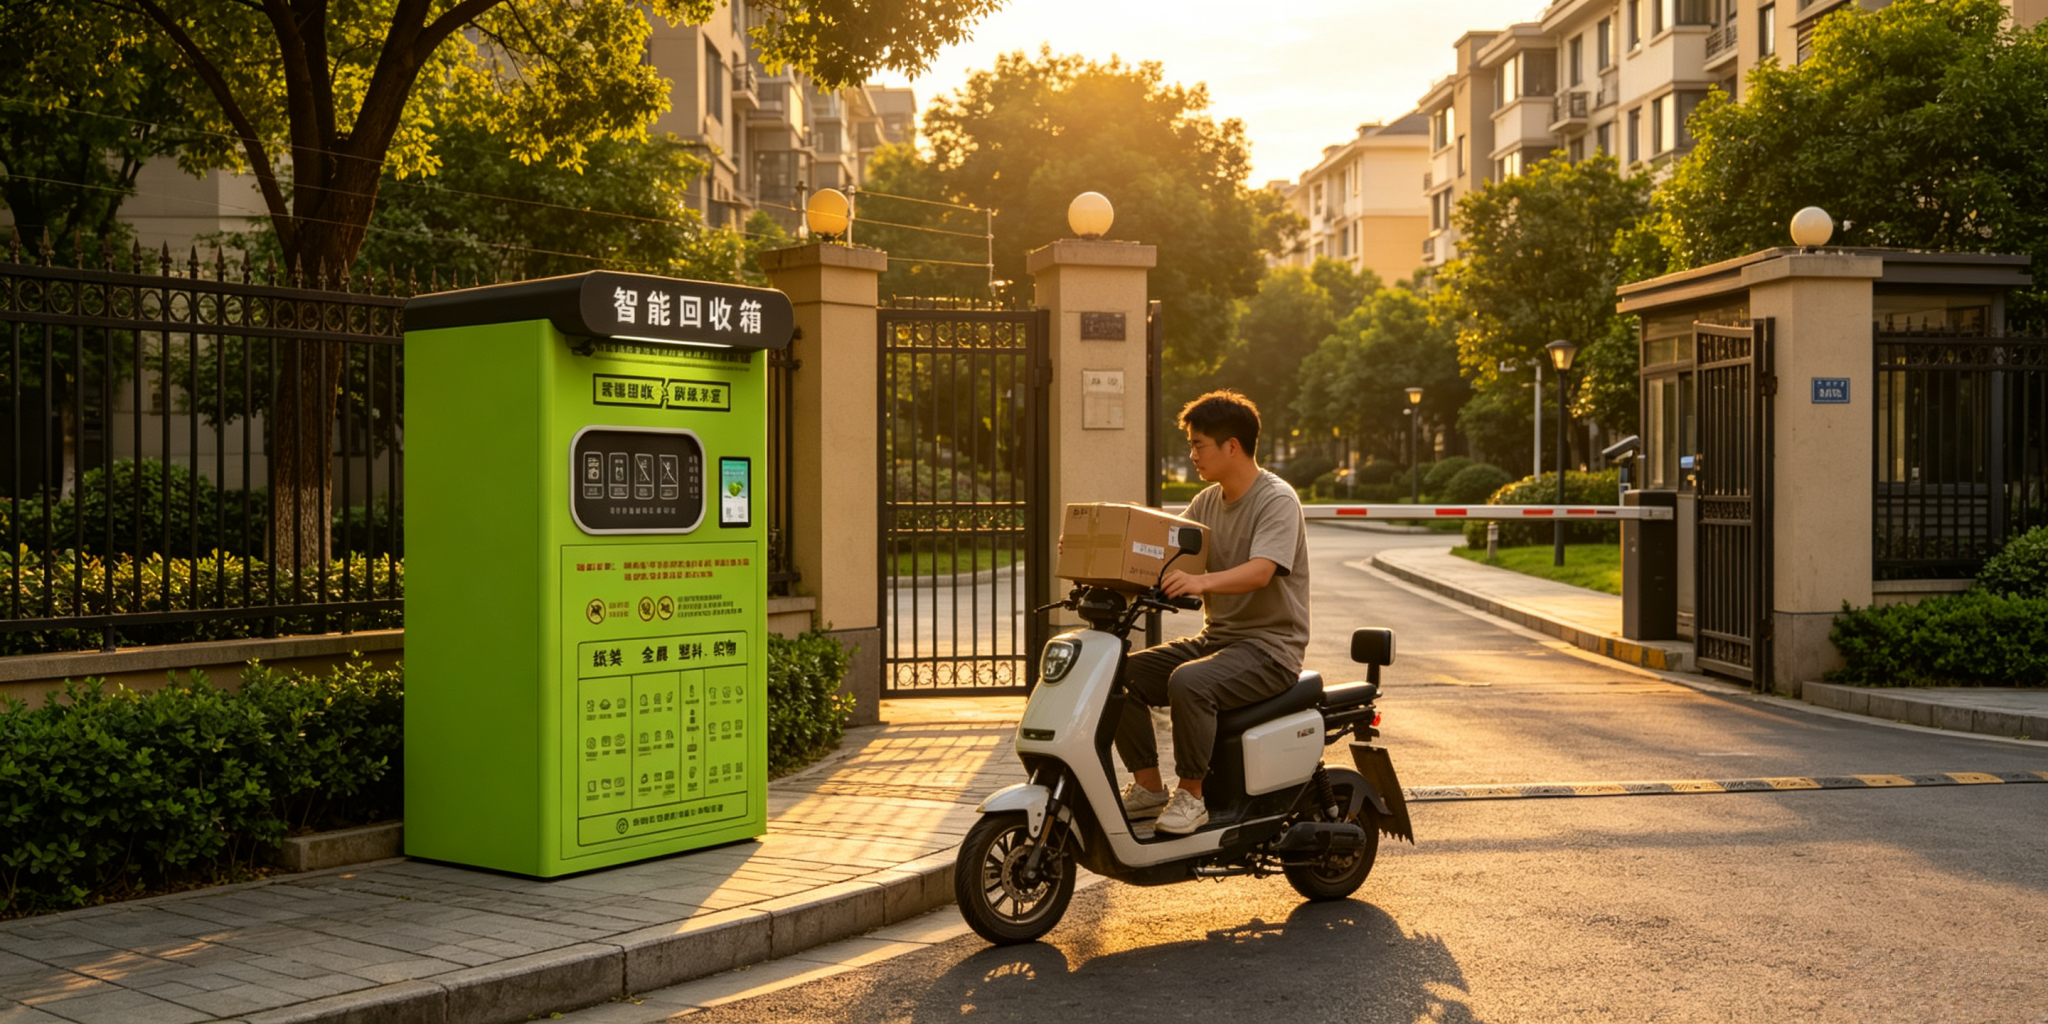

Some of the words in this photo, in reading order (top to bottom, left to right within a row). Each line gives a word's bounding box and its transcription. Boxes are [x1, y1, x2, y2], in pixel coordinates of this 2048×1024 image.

[613, 286, 762, 334] 智能回收箱
